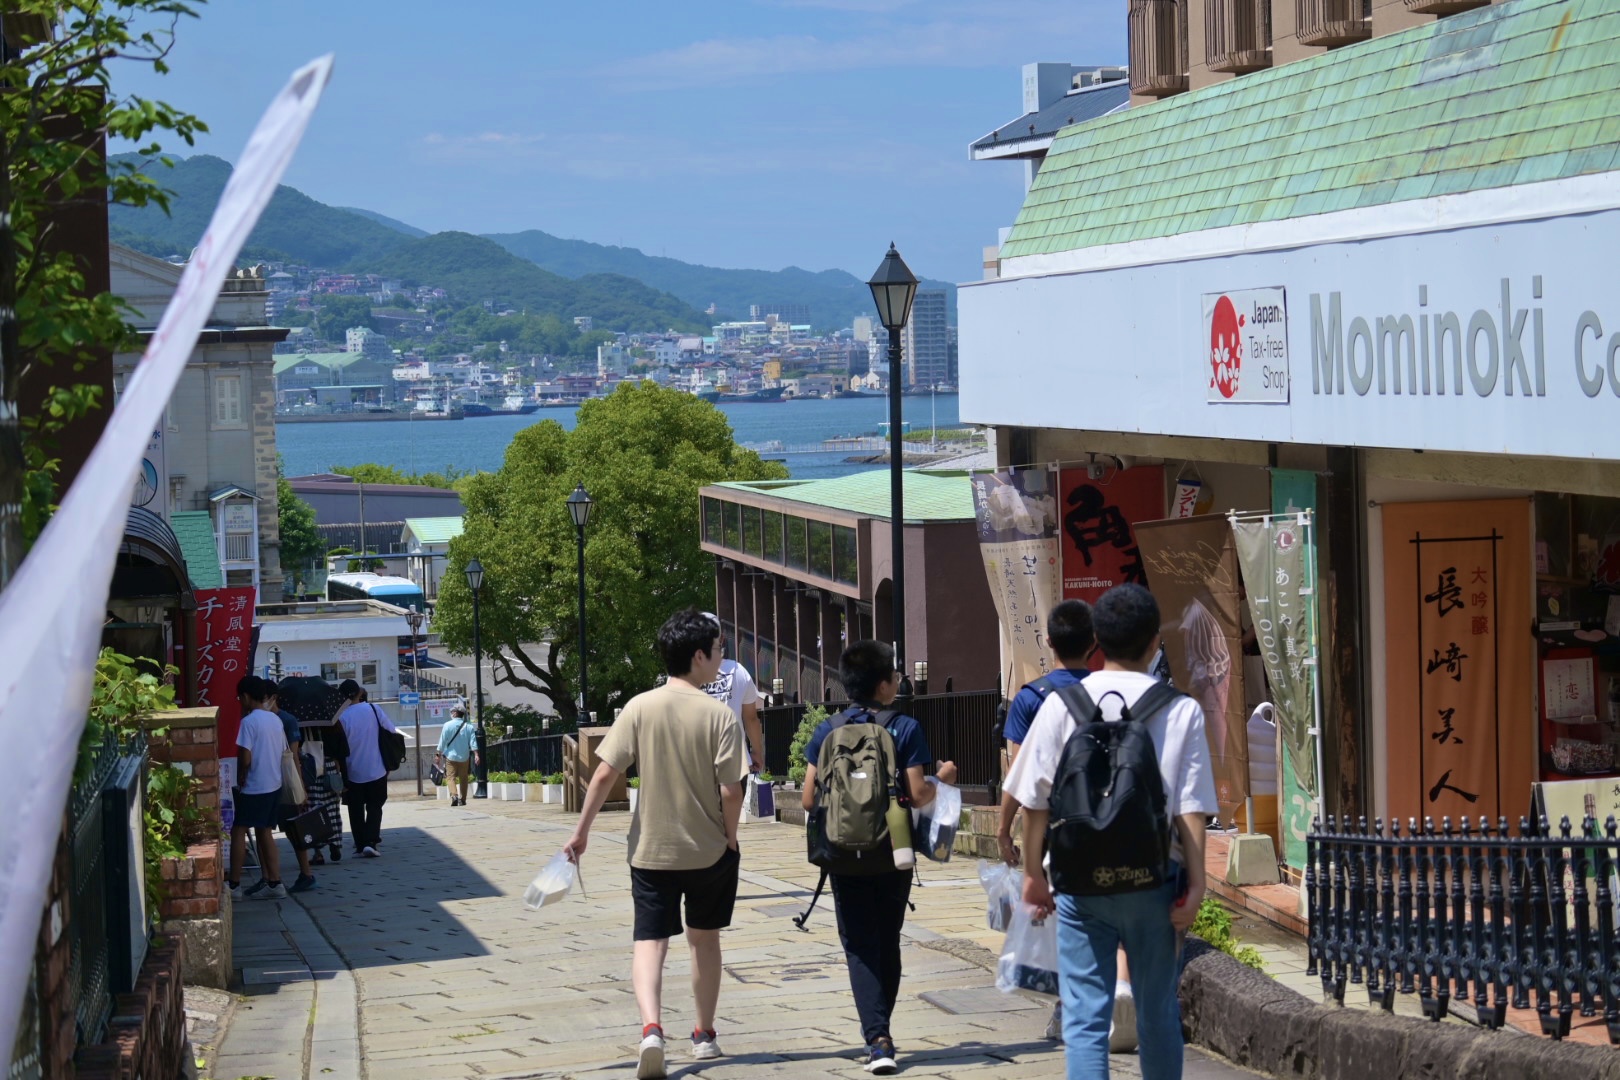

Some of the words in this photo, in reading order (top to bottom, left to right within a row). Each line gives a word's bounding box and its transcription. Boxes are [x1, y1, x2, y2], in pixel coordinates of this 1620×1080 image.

[1248, 334, 1284, 359] Tax-free
[1251, 300, 1282, 329] Japan.
[1309, 275, 1546, 398] Mominoki
[1262, 365, 1285, 395] Shop
[222, 595, 248, 672] 清風堂の
[1276, 567, 1303, 684] あこや真珠
[1470, 566, 1489, 636] 大吟醸
